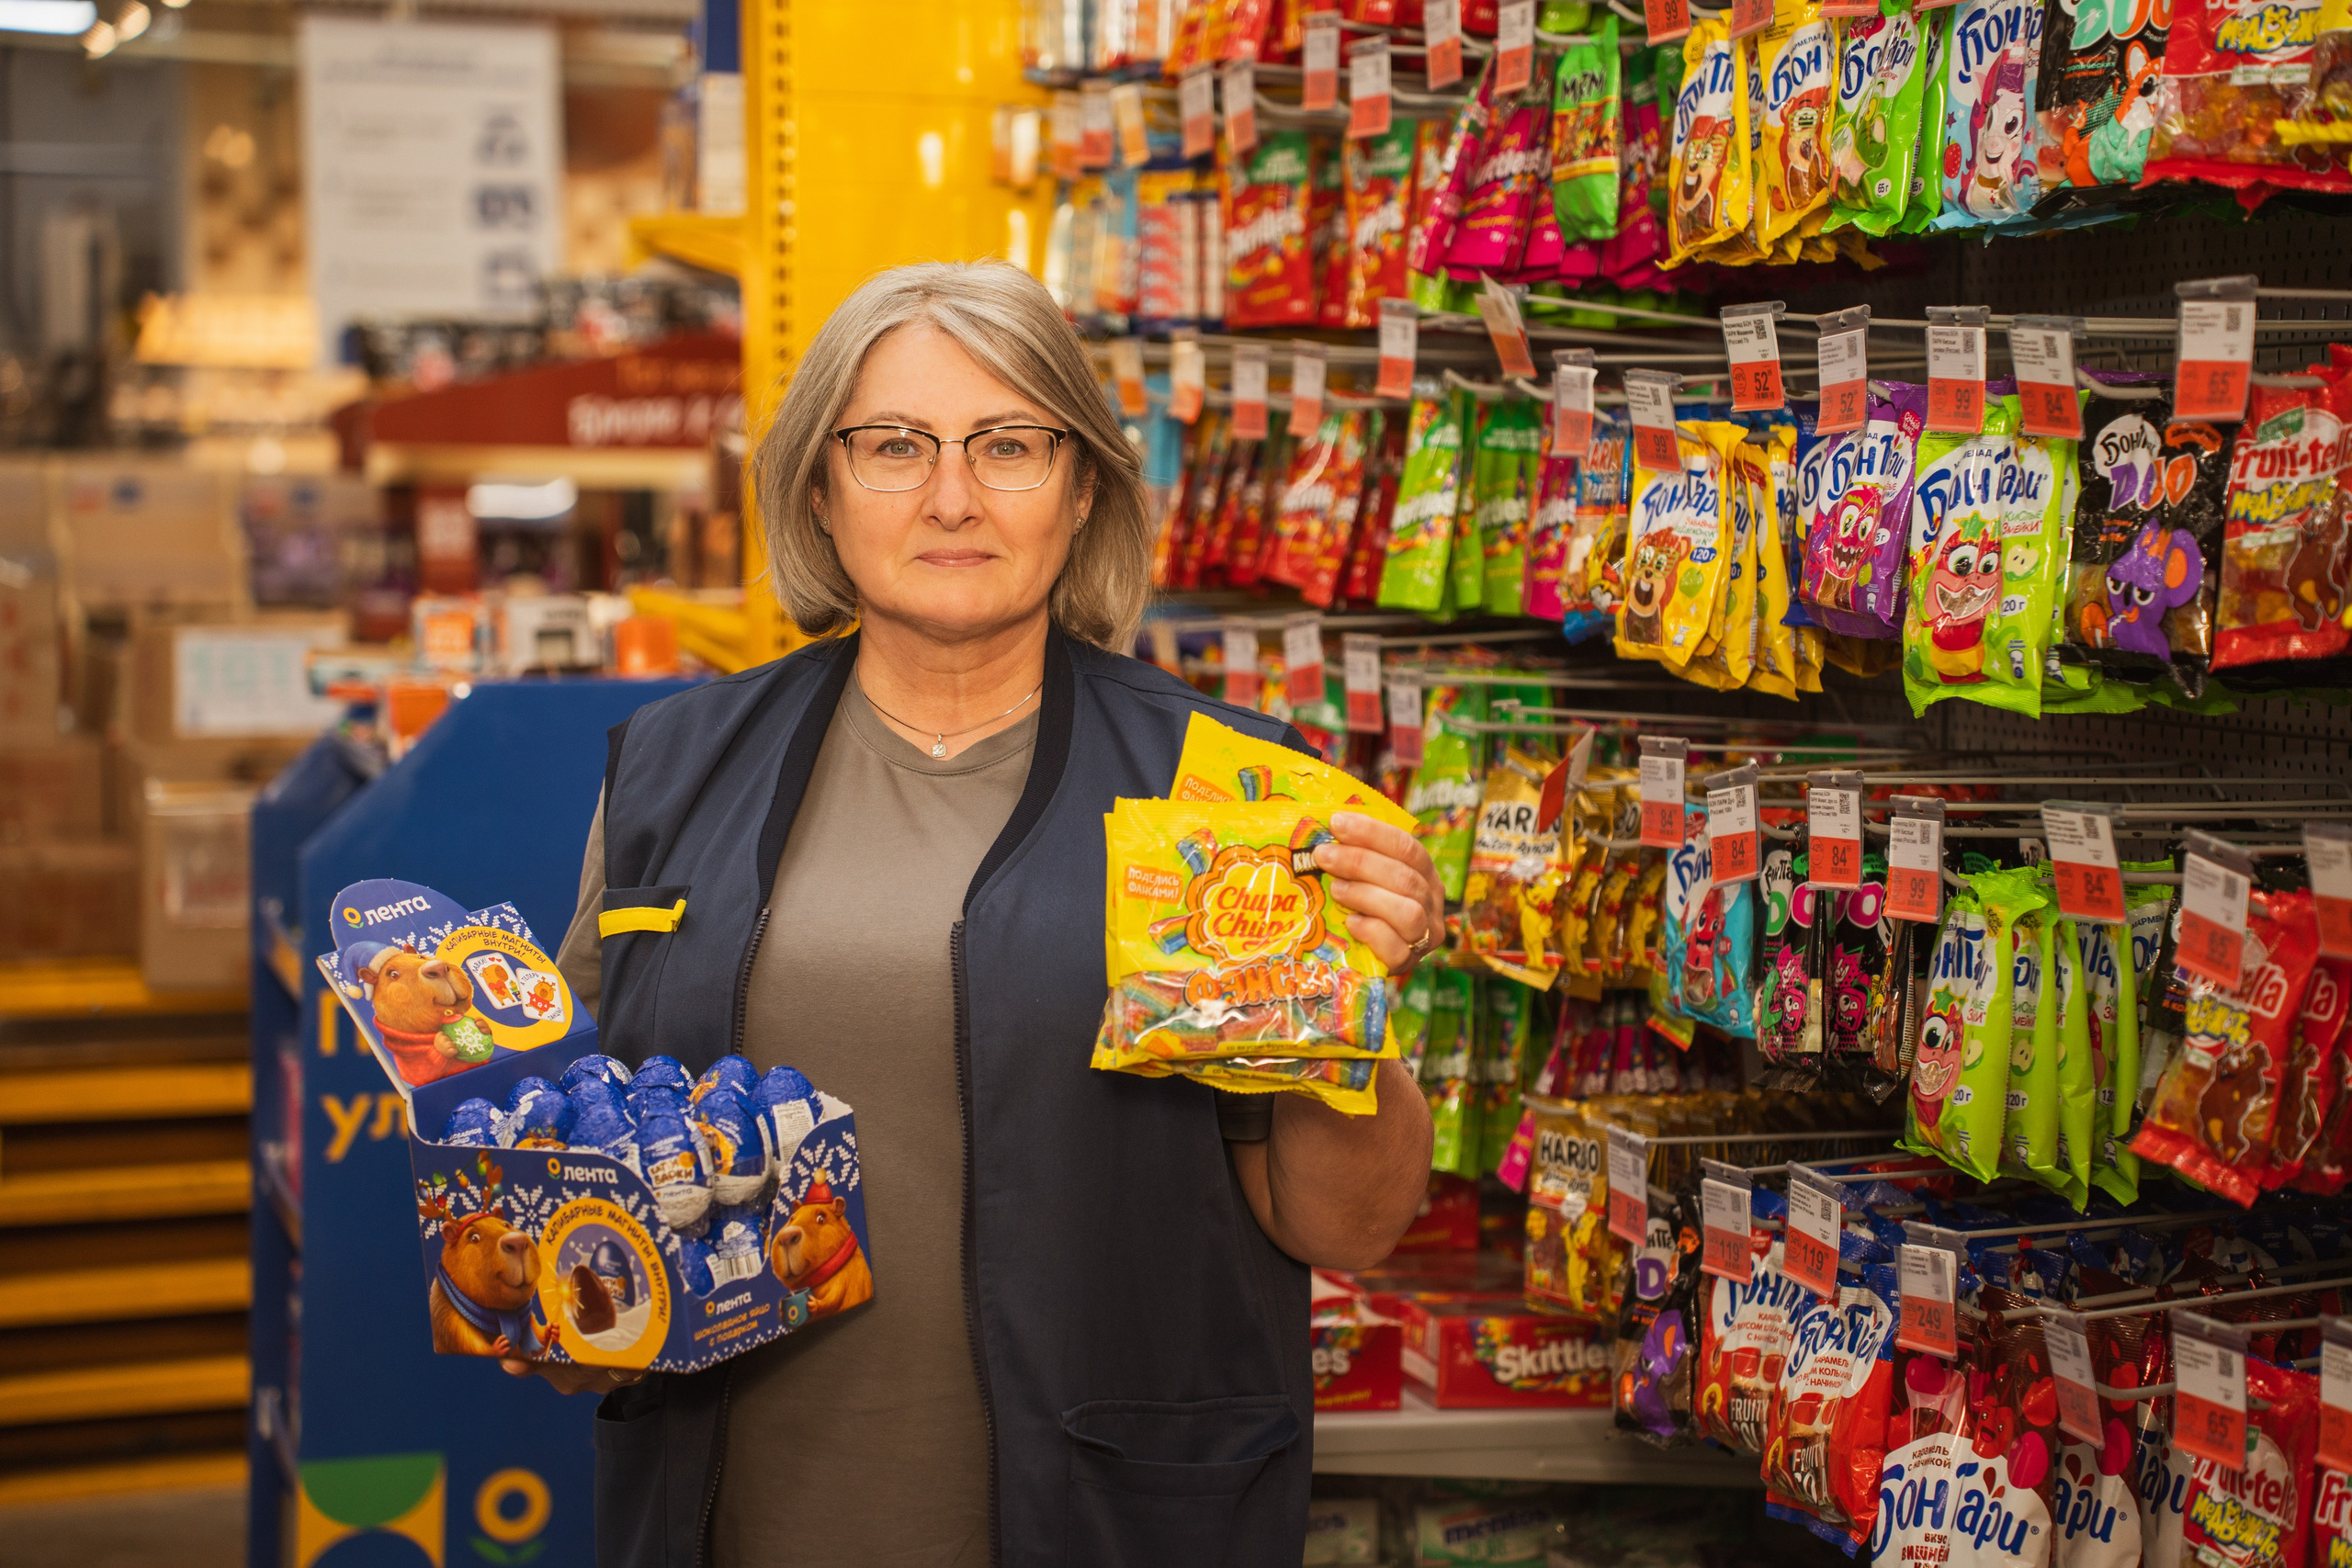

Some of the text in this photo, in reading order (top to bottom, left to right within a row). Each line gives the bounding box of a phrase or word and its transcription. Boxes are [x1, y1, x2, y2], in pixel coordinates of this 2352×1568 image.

[1770, 45, 1822, 111] Бон
[1754, 371, 1770, 392] 52
[1840, 392, 1854, 413] 52
[1955, 389, 1971, 411] 99
[1654, 434, 1668, 454] 99
[1827, 443, 1876, 501] Бн
[1643, 482, 1687, 534] Бон
[1917, 468, 1991, 542] Бон
[1691, 548, 1707, 561] 120
[1660, 809, 1674, 828] 84
[1731, 840, 1745, 860] 84
[1832, 846, 1847, 866] 84
[1128, 865, 1180, 886] ПОДЕЛИСЬ
[1127, 882, 1179, 898] ФАНСАМИ!
[1910, 877, 1926, 899] 99
[365, 895, 431, 926] лента
[1217, 886, 1298, 916] Chupa
[1213, 915, 1295, 950] Chups
[445, 930, 547, 964] КАПИБАРНЫЕ МАГНИТЫ
[483, 939, 525, 958] ВНУТРИ!
[525, 972, 539, 983] ТЕПЕРЬ
[563, 1165, 618, 1184] лента
[1720, 1238, 1740, 1262] 119
[1803, 1243, 1824, 1271] 119
[546, 1205, 668, 1324] КАПИБАРНЫЕ МАГНИТЫ ВНУТРИ!
[717, 1292, 752, 1315] лента
[1917, 1306, 1941, 1329] 249
[1730, 1398, 1770, 1421] FRUITY
[1793, 1442, 1825, 1472] FRUITY
[1871, 1462, 2029, 1556] Бон ари
[2054, 1477, 2117, 1543] ари
[1924, 1533, 1948, 1544] ВКУС
